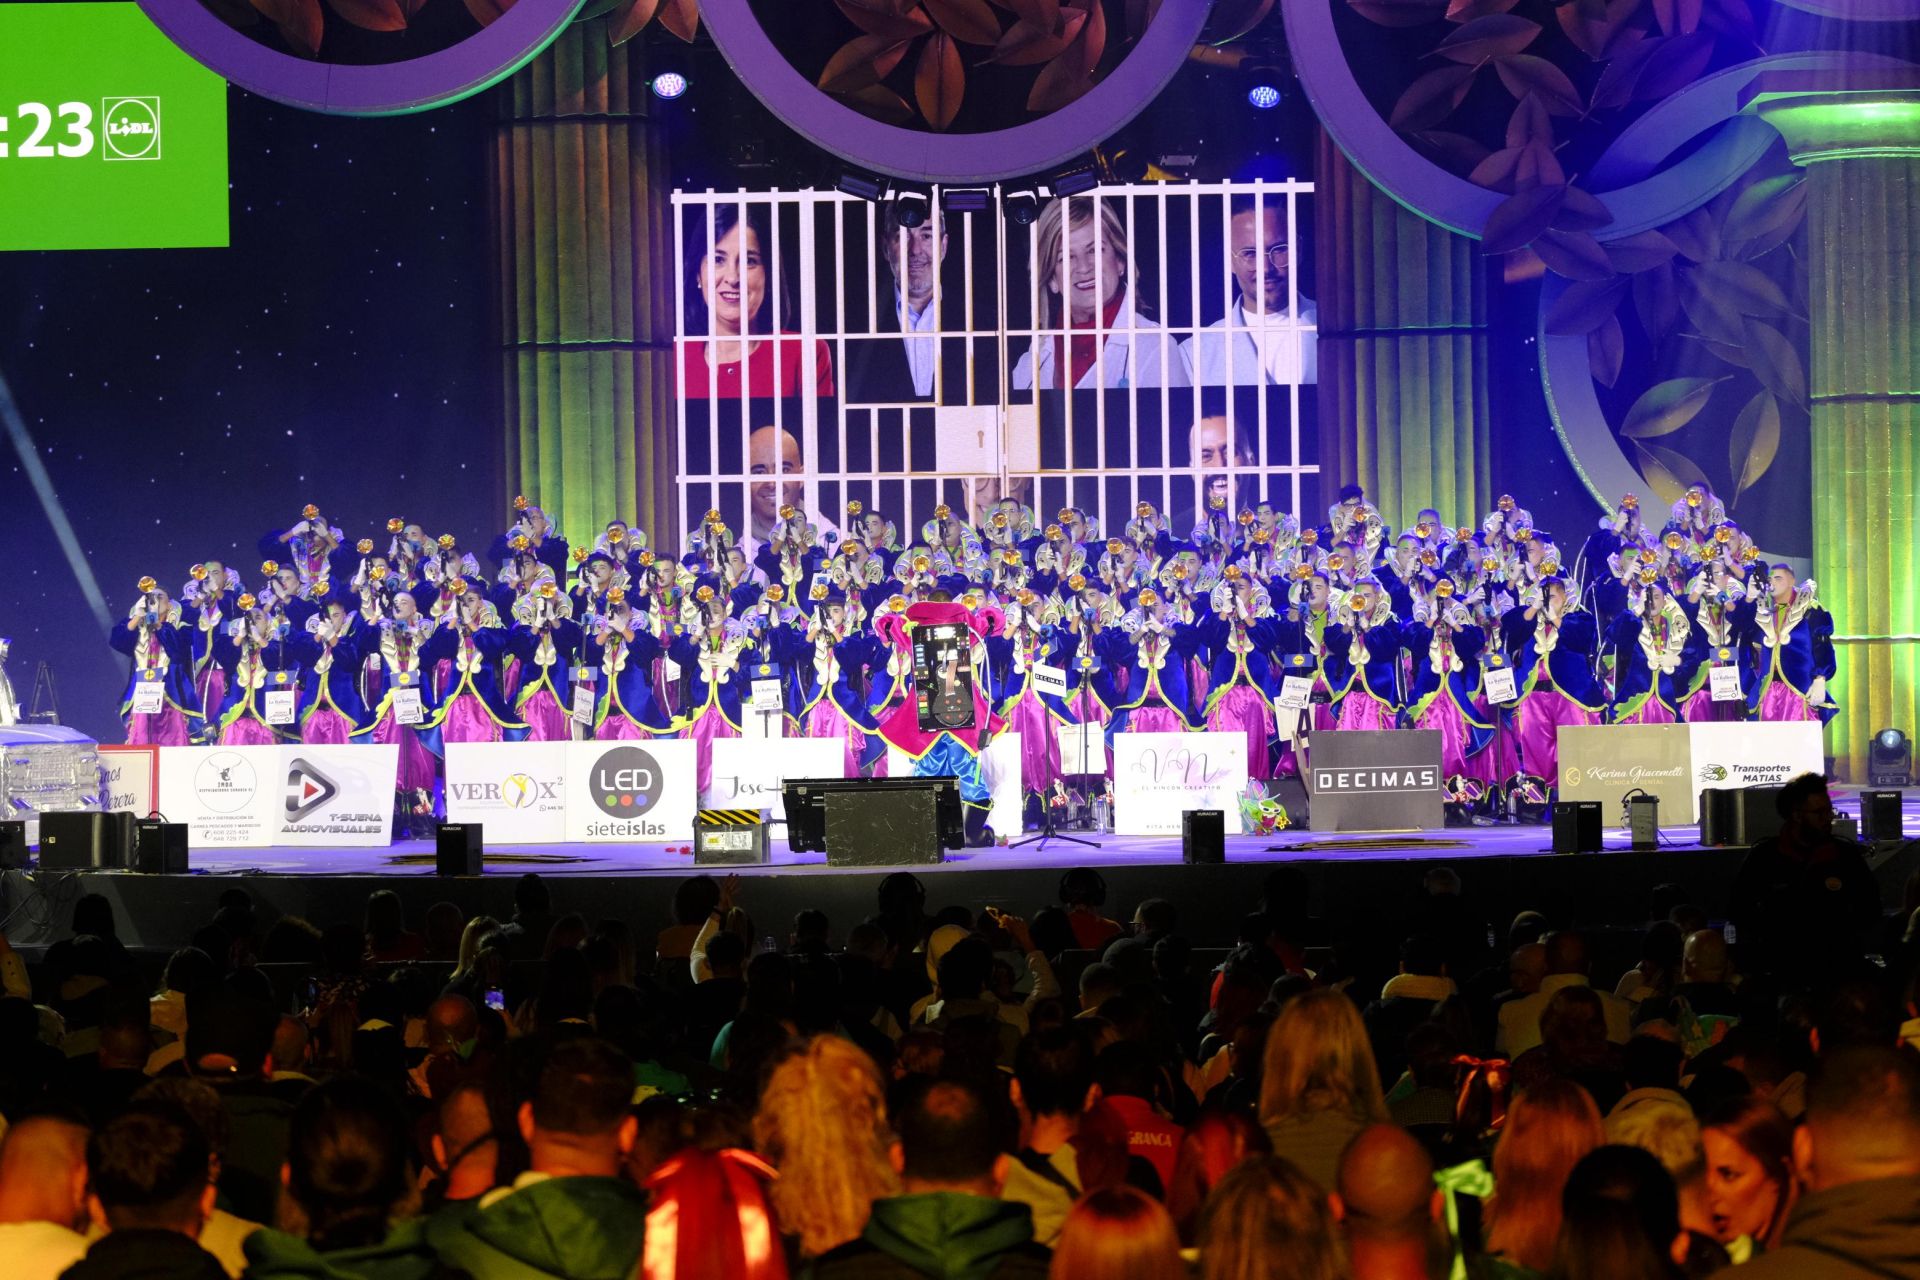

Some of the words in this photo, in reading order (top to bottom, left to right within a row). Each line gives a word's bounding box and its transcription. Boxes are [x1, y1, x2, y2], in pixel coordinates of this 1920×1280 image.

[1035, 674, 1064, 686] DECIMAS
[1586, 767, 1627, 780] Karina
[1629, 765, 1684, 784] Giacomelli
[1732, 765, 1791, 773] Transportes
[600, 768, 652, 791] LED
[1320, 771, 1433, 788] DECIMAS
[1742, 774, 1782, 782] MATIAS
[329, 813, 382, 822] T-SUENA
[281, 825, 382, 834] AUDIOVISUALES
[586, 821, 666, 836] sieteislas
